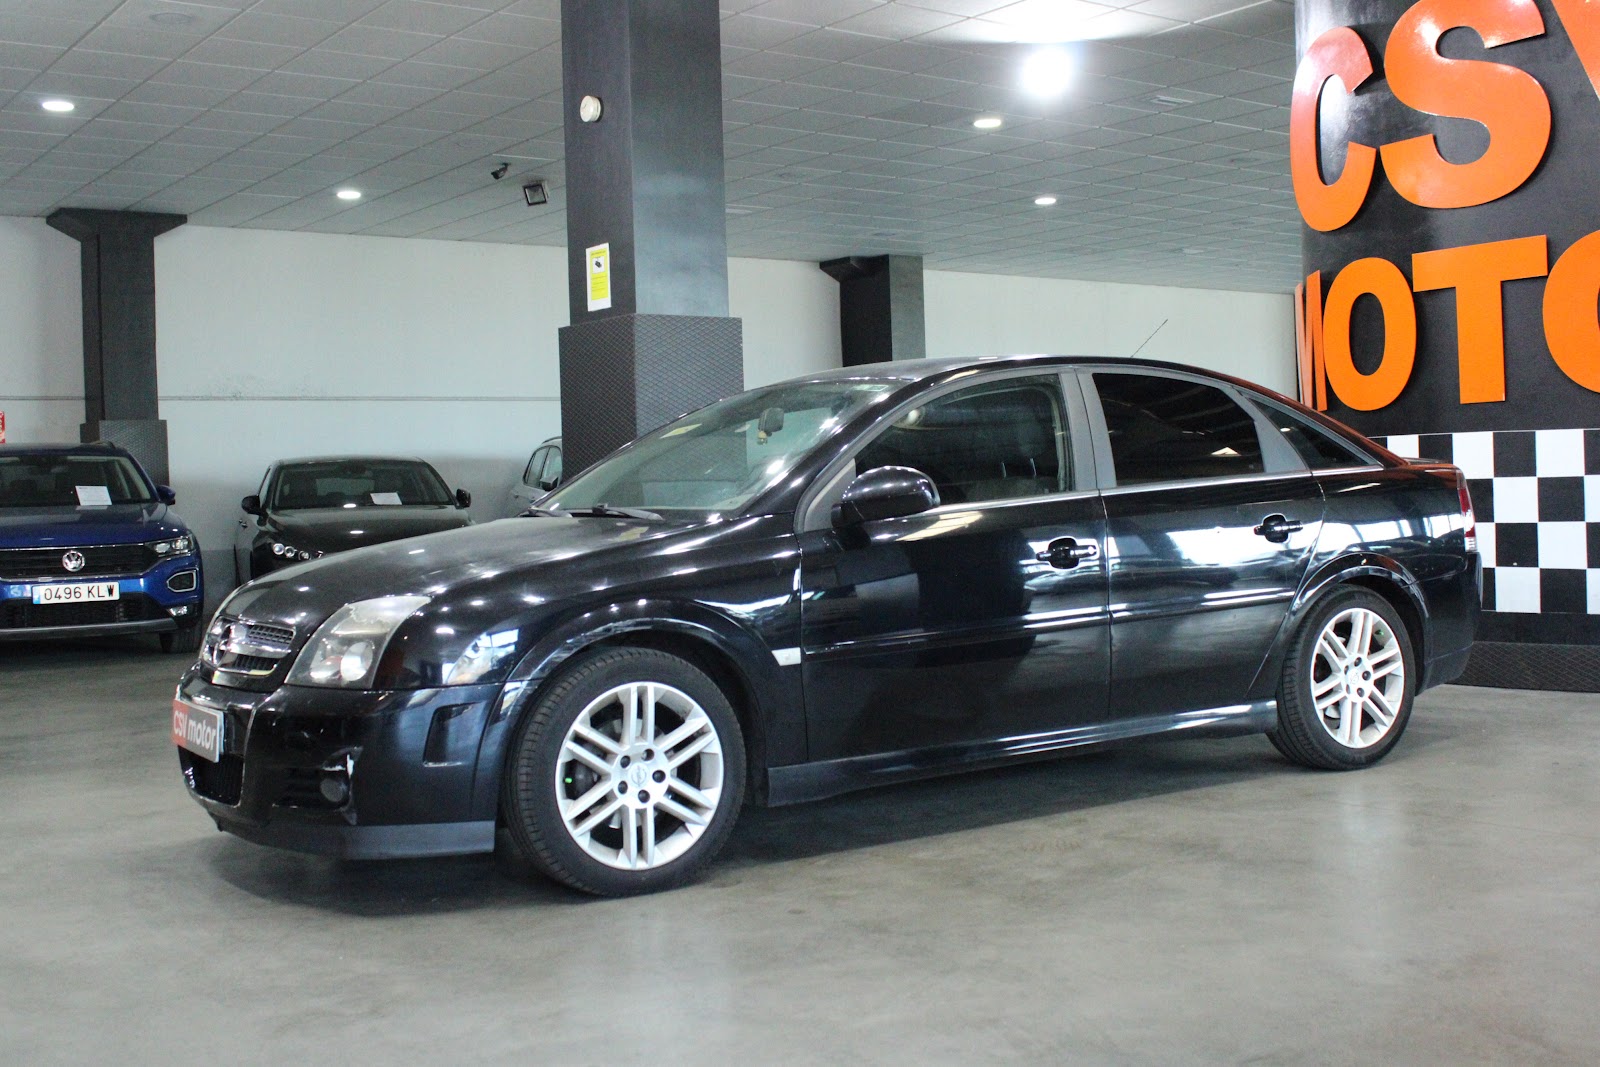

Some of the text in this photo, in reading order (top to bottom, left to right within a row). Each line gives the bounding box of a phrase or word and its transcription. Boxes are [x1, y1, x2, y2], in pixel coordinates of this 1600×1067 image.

[44, 584, 115, 601] 0496 KLW
[173, 710, 217, 751] CSV motor
